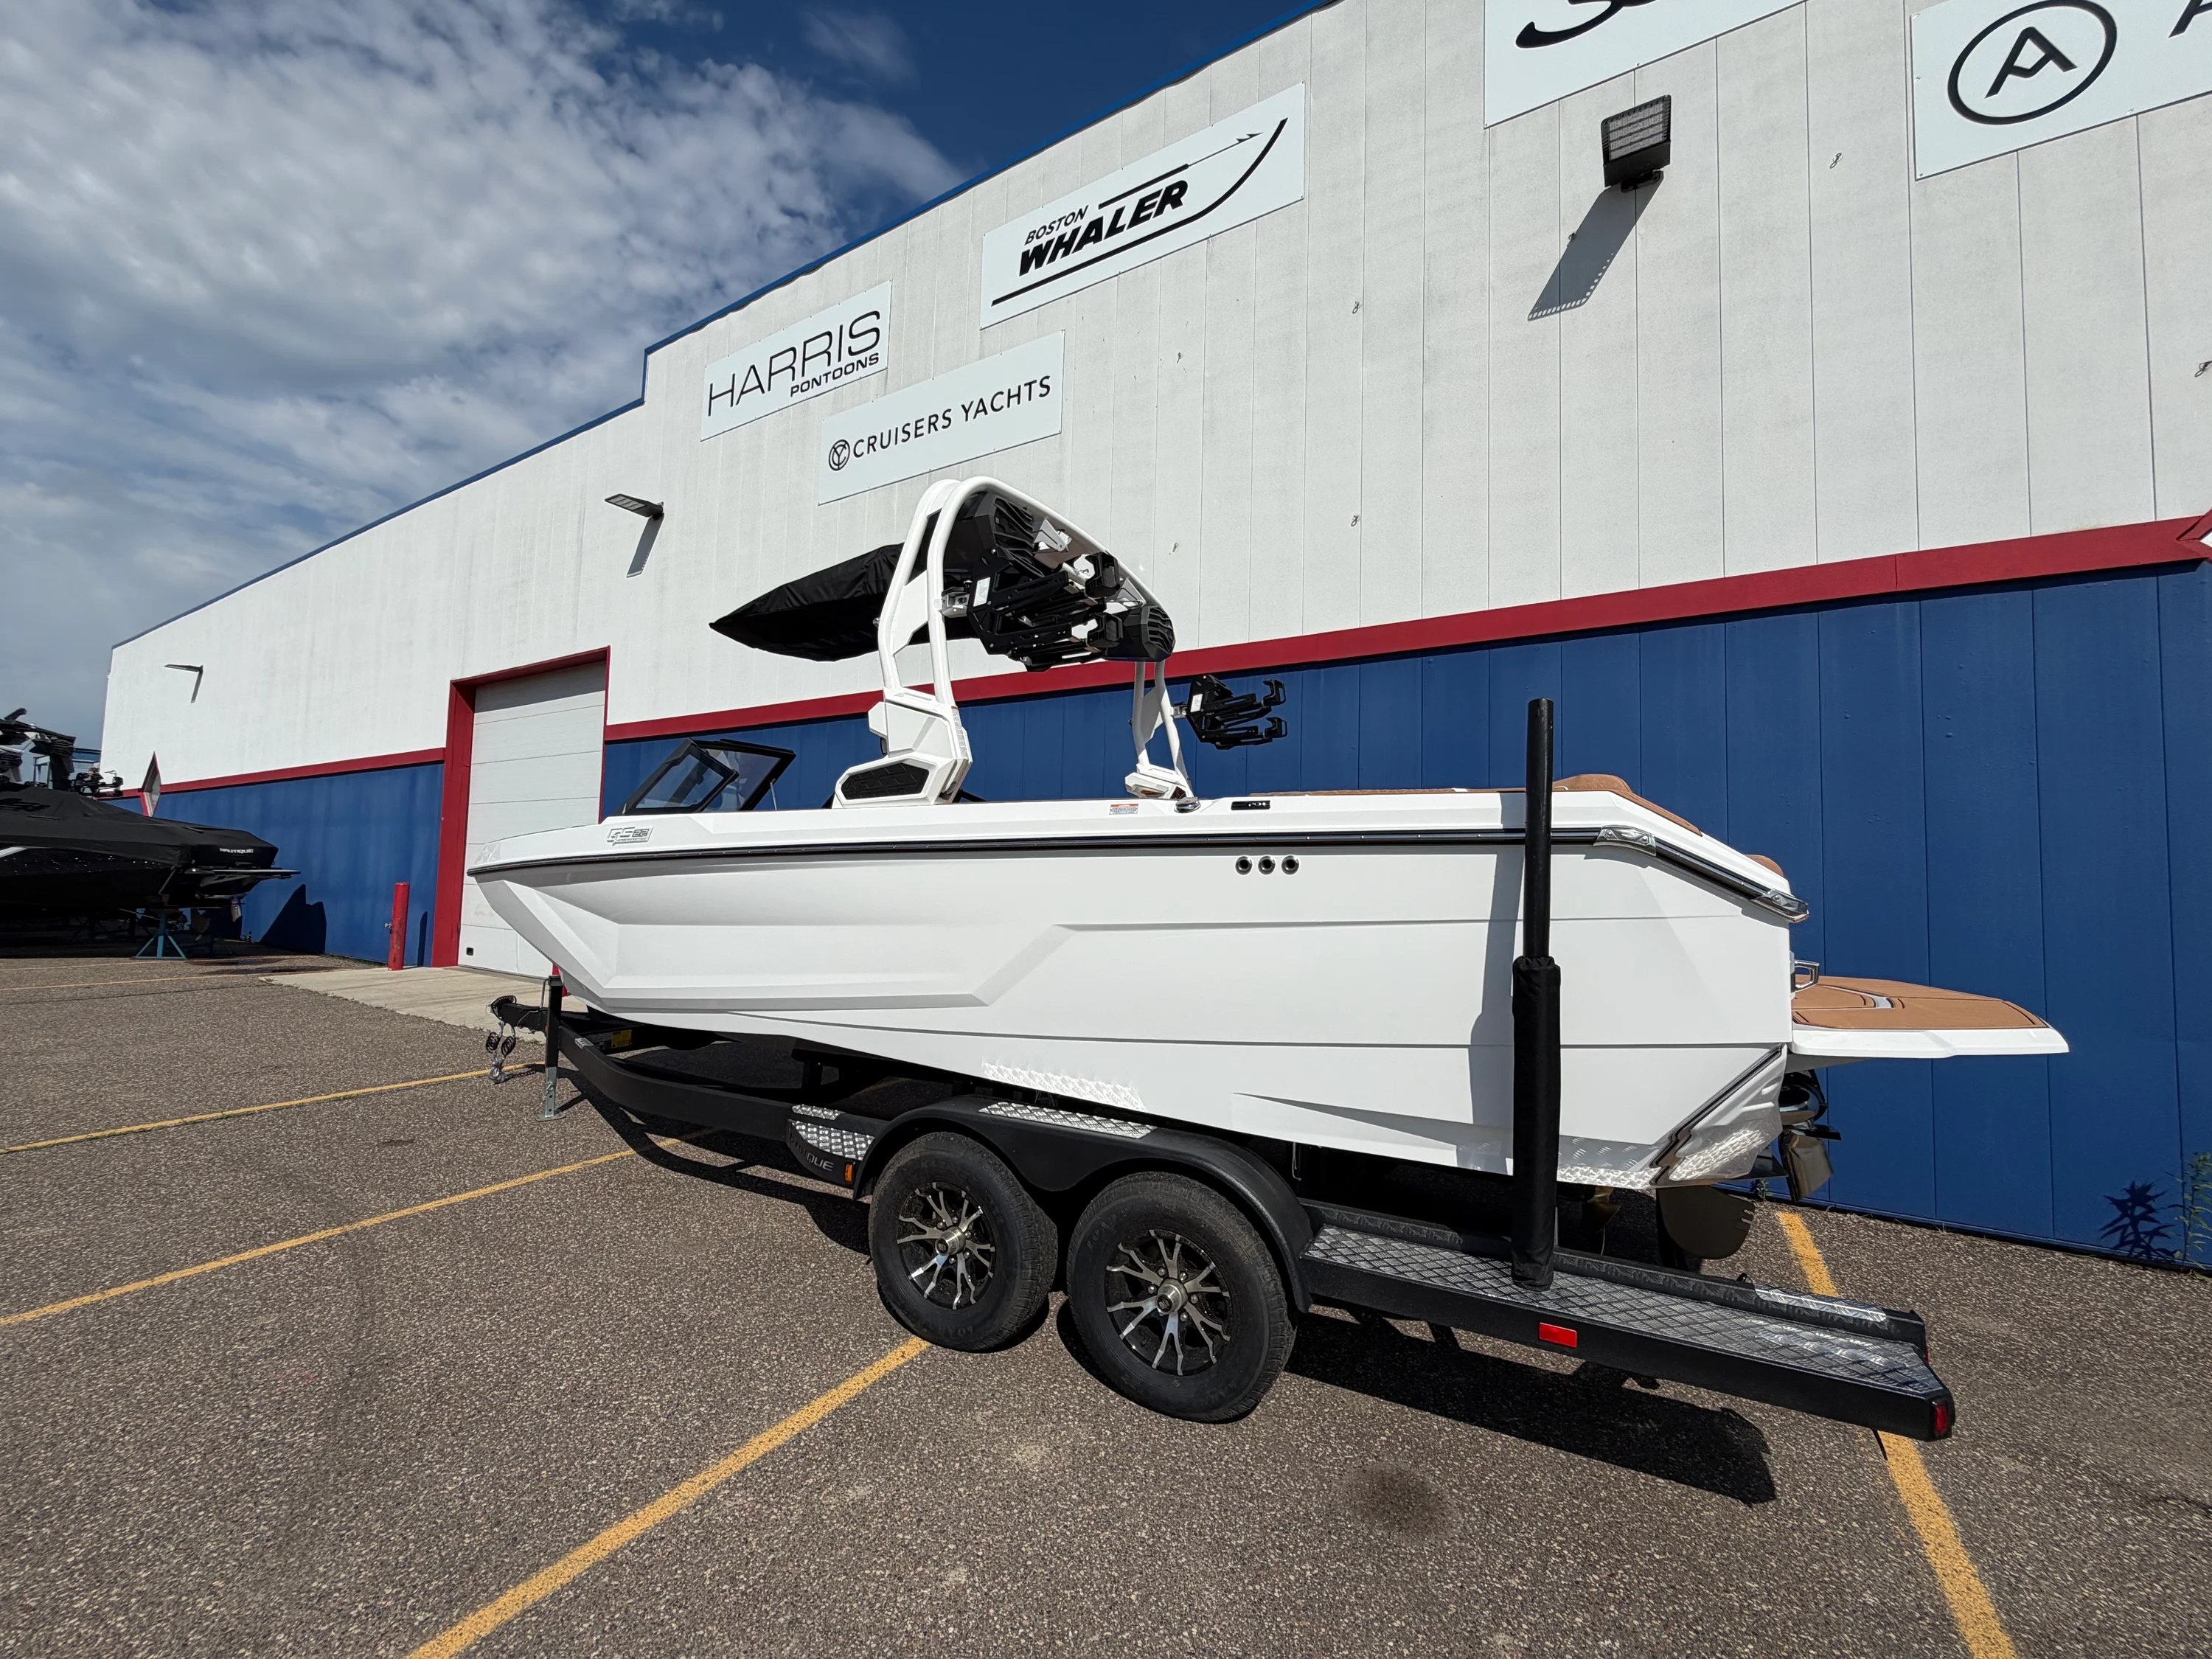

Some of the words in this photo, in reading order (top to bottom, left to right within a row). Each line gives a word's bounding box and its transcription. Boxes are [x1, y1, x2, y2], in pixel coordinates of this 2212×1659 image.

[1019, 180, 1189, 276] WHALER
[1024, 204, 1089, 246] BOSTON
[708, 310, 880, 417] HARRIS
[790, 352, 879, 397] PONTOONS
[853, 408, 952, 458] CRUISERS
[961, 375, 1051, 422] YACHTS
